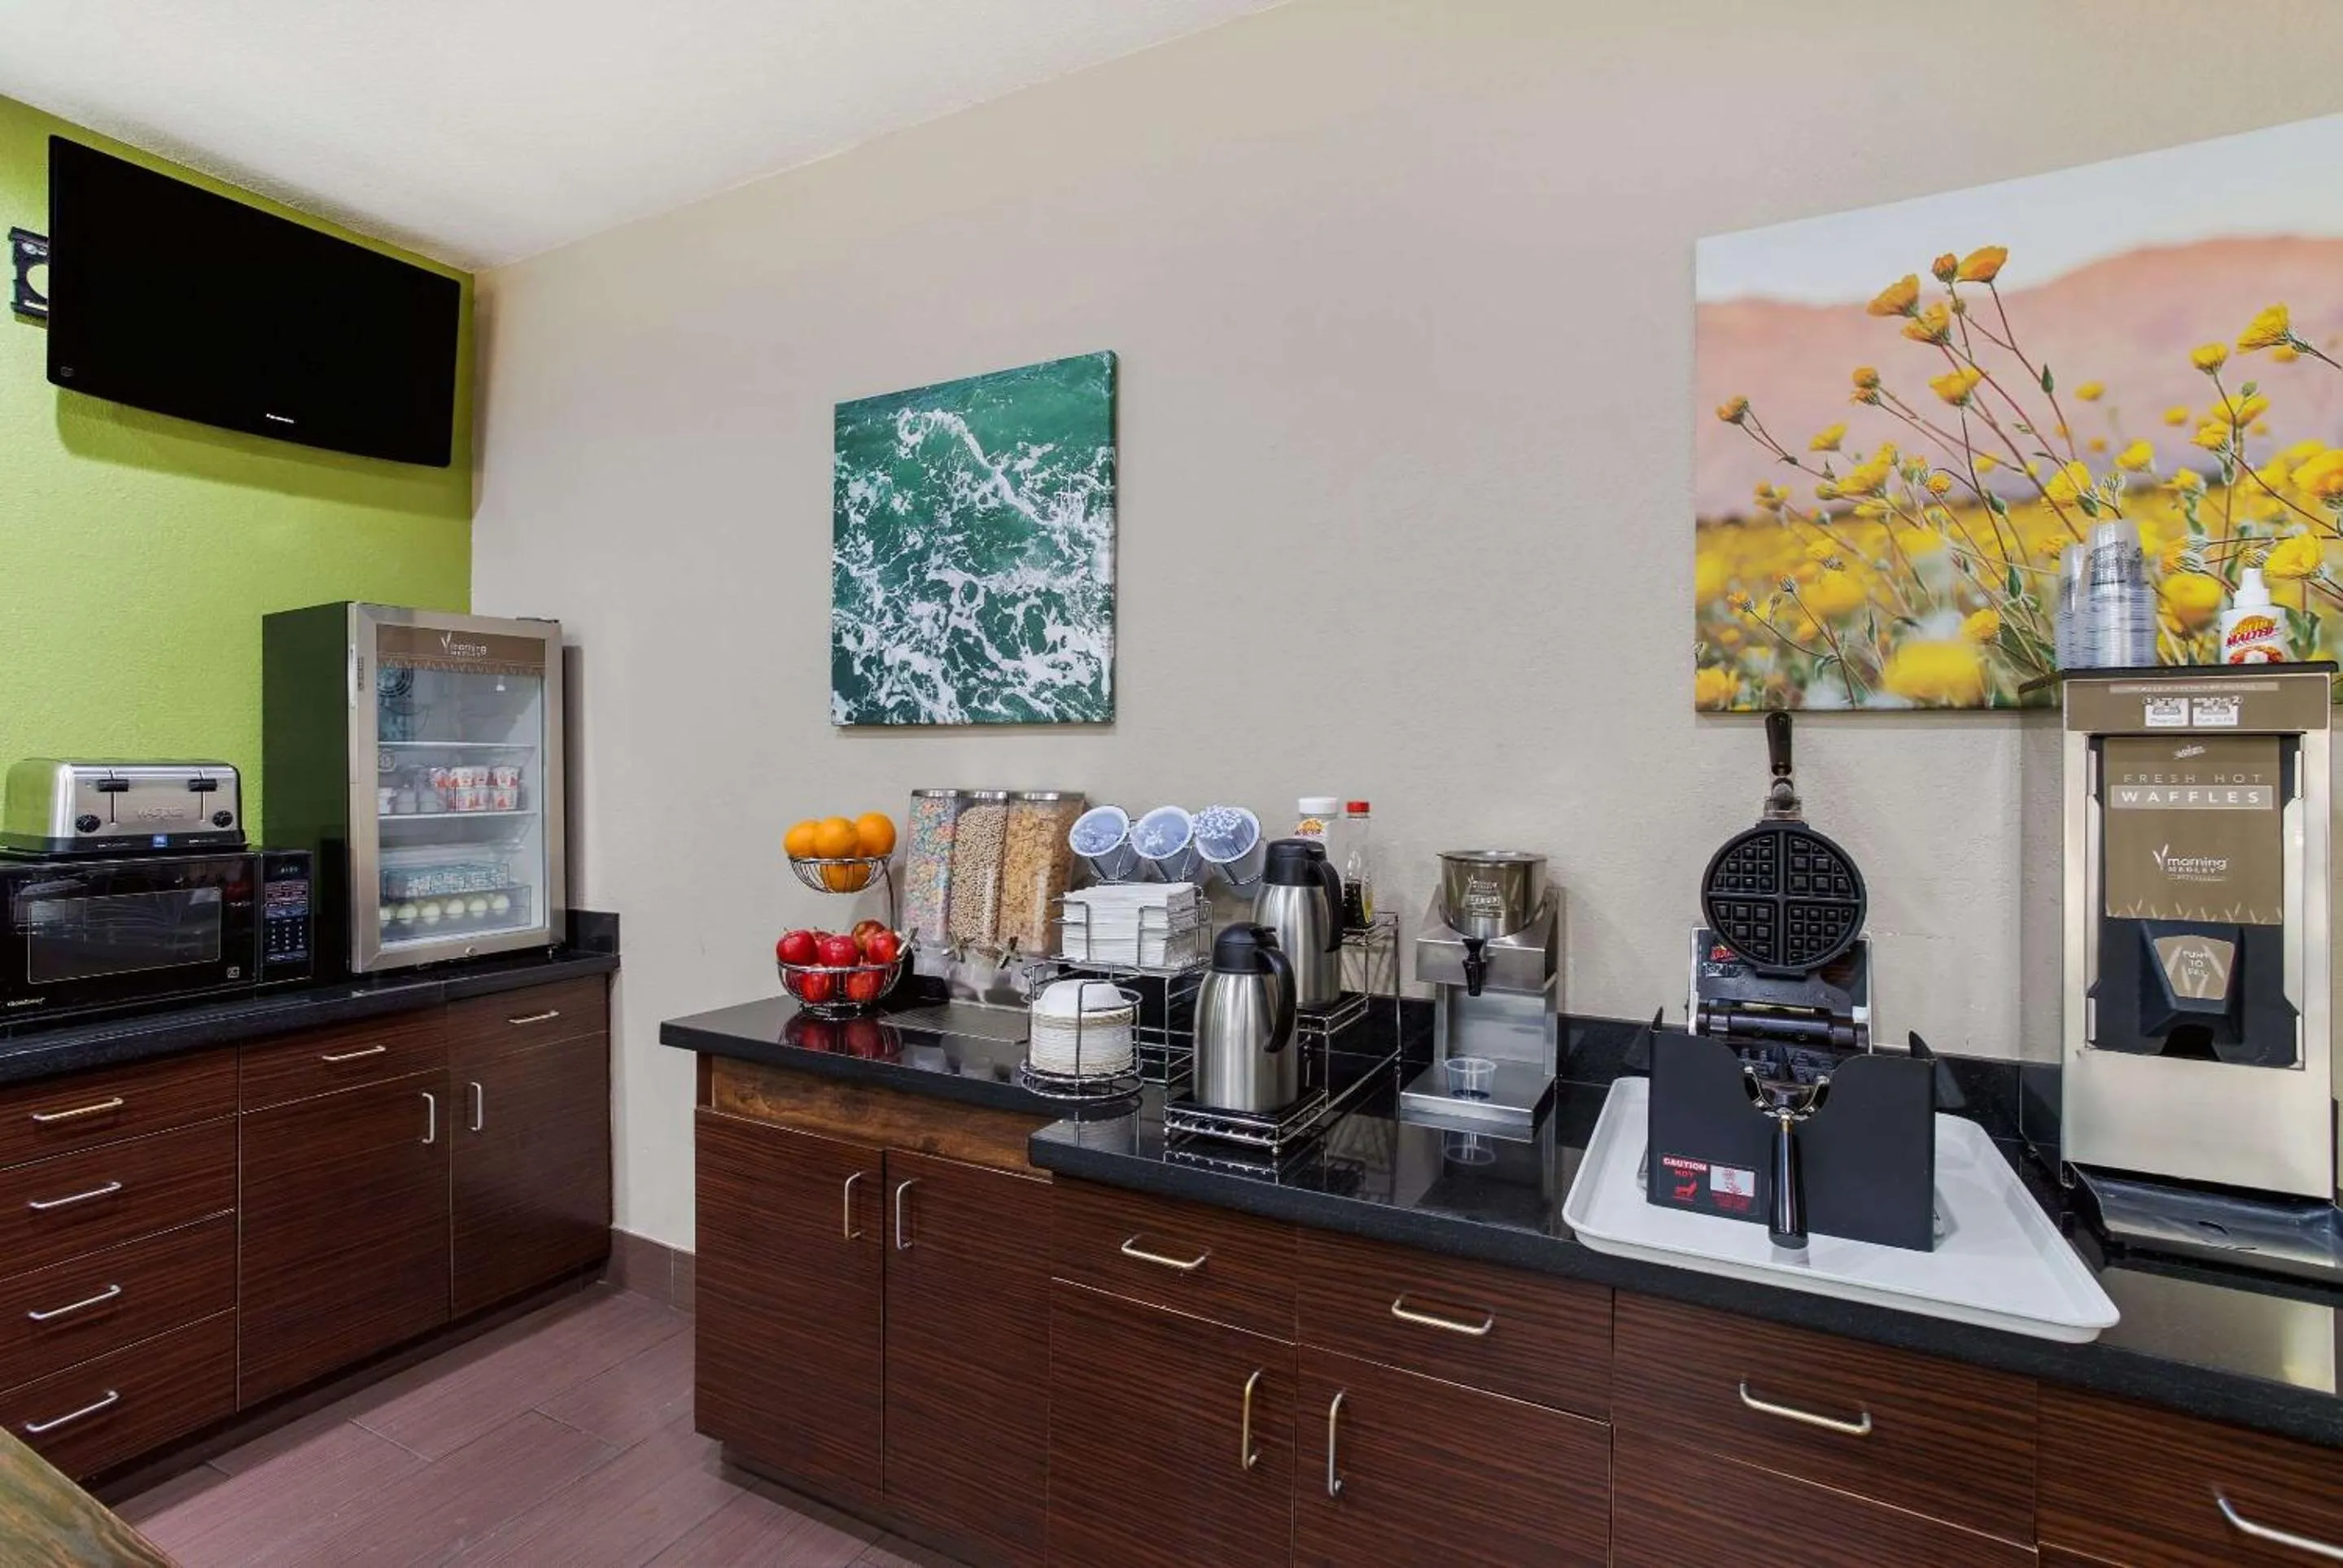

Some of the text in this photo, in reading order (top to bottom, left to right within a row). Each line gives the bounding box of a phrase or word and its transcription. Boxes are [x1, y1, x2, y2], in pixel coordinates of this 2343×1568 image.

[2124, 774, 2262, 783] FRESH HOT
[2122, 791, 2259, 803] WAFFLES
[2167, 857, 2227, 871] morning
[1663, 1158, 1707, 1171] CAUTION
